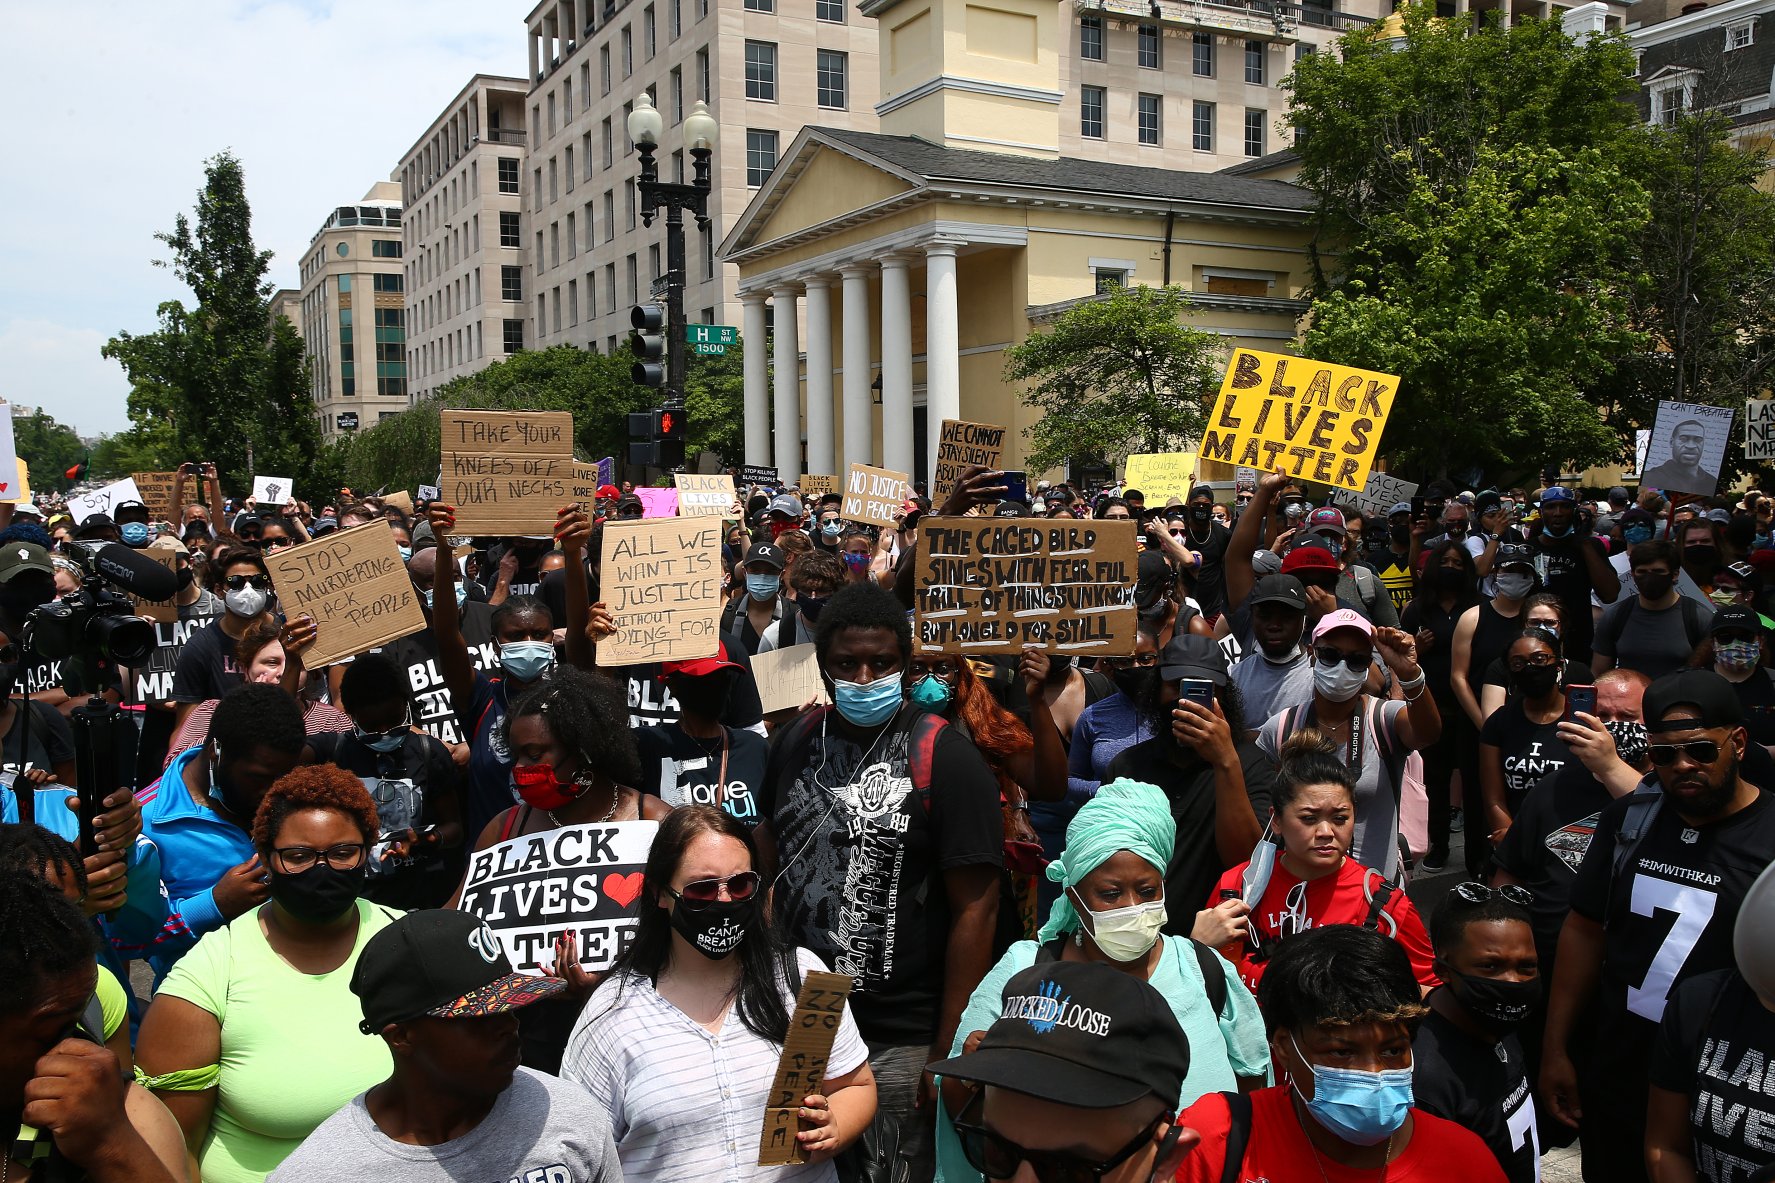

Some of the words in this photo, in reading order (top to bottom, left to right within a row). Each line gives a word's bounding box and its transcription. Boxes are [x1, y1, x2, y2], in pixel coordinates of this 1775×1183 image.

[697, 328, 708, 342] H
[697, 344, 724, 353] 1500
[1231, 353, 1389, 418] BLACK
[1658, 401, 1668, 410] I
[1694, 406, 1733, 418] BREATHE
[453, 420, 511, 444] TAKE
[516, 420, 561, 446] YOUR
[943, 422, 963, 443] WE
[964, 424, 1006, 448] CANNOT
[1219, 394, 1373, 455] LIVES
[454, 452, 514, 476] KNEES
[524, 459, 560, 476] OFF
[938, 443, 962, 464] STAY
[962, 446, 1000, 468] SILENT
[1202, 430, 1360, 486] MATTER
[572, 468, 597, 482] LIVES
[679, 475, 728, 492] BLACK
[850, 470, 867, 494] NO
[869, 475, 906, 501] JUSTICE
[456, 478, 498, 506] OUR
[508, 480, 565, 498] NECKS
[686, 494, 727, 504] LIVES
[1336, 490, 1390, 516] MATTE
[846, 498, 862, 516] NO
[866, 500, 897, 522] PEACE
[612, 534, 669, 562] ALL
[678, 530, 718, 550] WE
[926, 528, 972, 554] THE
[976, 526, 1044, 554] CAGED
[1048, 528, 1096, 552] BIRD
[100, 557, 135, 582] ZOOM
[279, 542, 352, 584] STOP
[616, 560, 677, 582] WANT
[683, 552, 712, 574] IS
[994, 558, 1047, 584] WITH
[1550, 556, 1576, 568] NADA
[294, 556, 396, 608] MURDERING
[614, 578, 716, 611] JUSTICE
[344, 590, 412, 628] PEOPLE
[980, 590, 1004, 611] OF
[1002, 585, 1068, 612] THINGS
[612, 609, 676, 628] WITHOUT
[612, 626, 670, 646] DYING
[680, 618, 715, 638] FOR
[920, 620, 950, 643] BUT
[1021, 620, 1056, 643] FOR
[1054, 616, 1114, 643] STILL
[641, 638, 682, 658] IT
[628, 677, 681, 712] BLA
[1530, 742, 1542, 756] I
[1504, 756, 1565, 774] CAN'T
[468, 828, 620, 886] BLACK
[842, 845, 869, 902] Since
[887, 850, 904, 910] REGISTERED
[1638, 858, 1722, 886] #IMWITHKAP
[464, 874, 598, 922] LIVES
[708, 924, 740, 937] CAN'T
[723, 918, 730, 926] I
[828, 906, 862, 952] Day
[514, 925, 640, 970] TTER
[698, 929, 745, 946] BREATHE
[882, 911, 896, 973] TRADEMARK
[1626, 873, 1718, 1024] 7
[1000, 995, 1058, 1022] KNOCKED
[1056, 1000, 1112, 1037] LOOSE
[1506, 1092, 1542, 1183] 7
